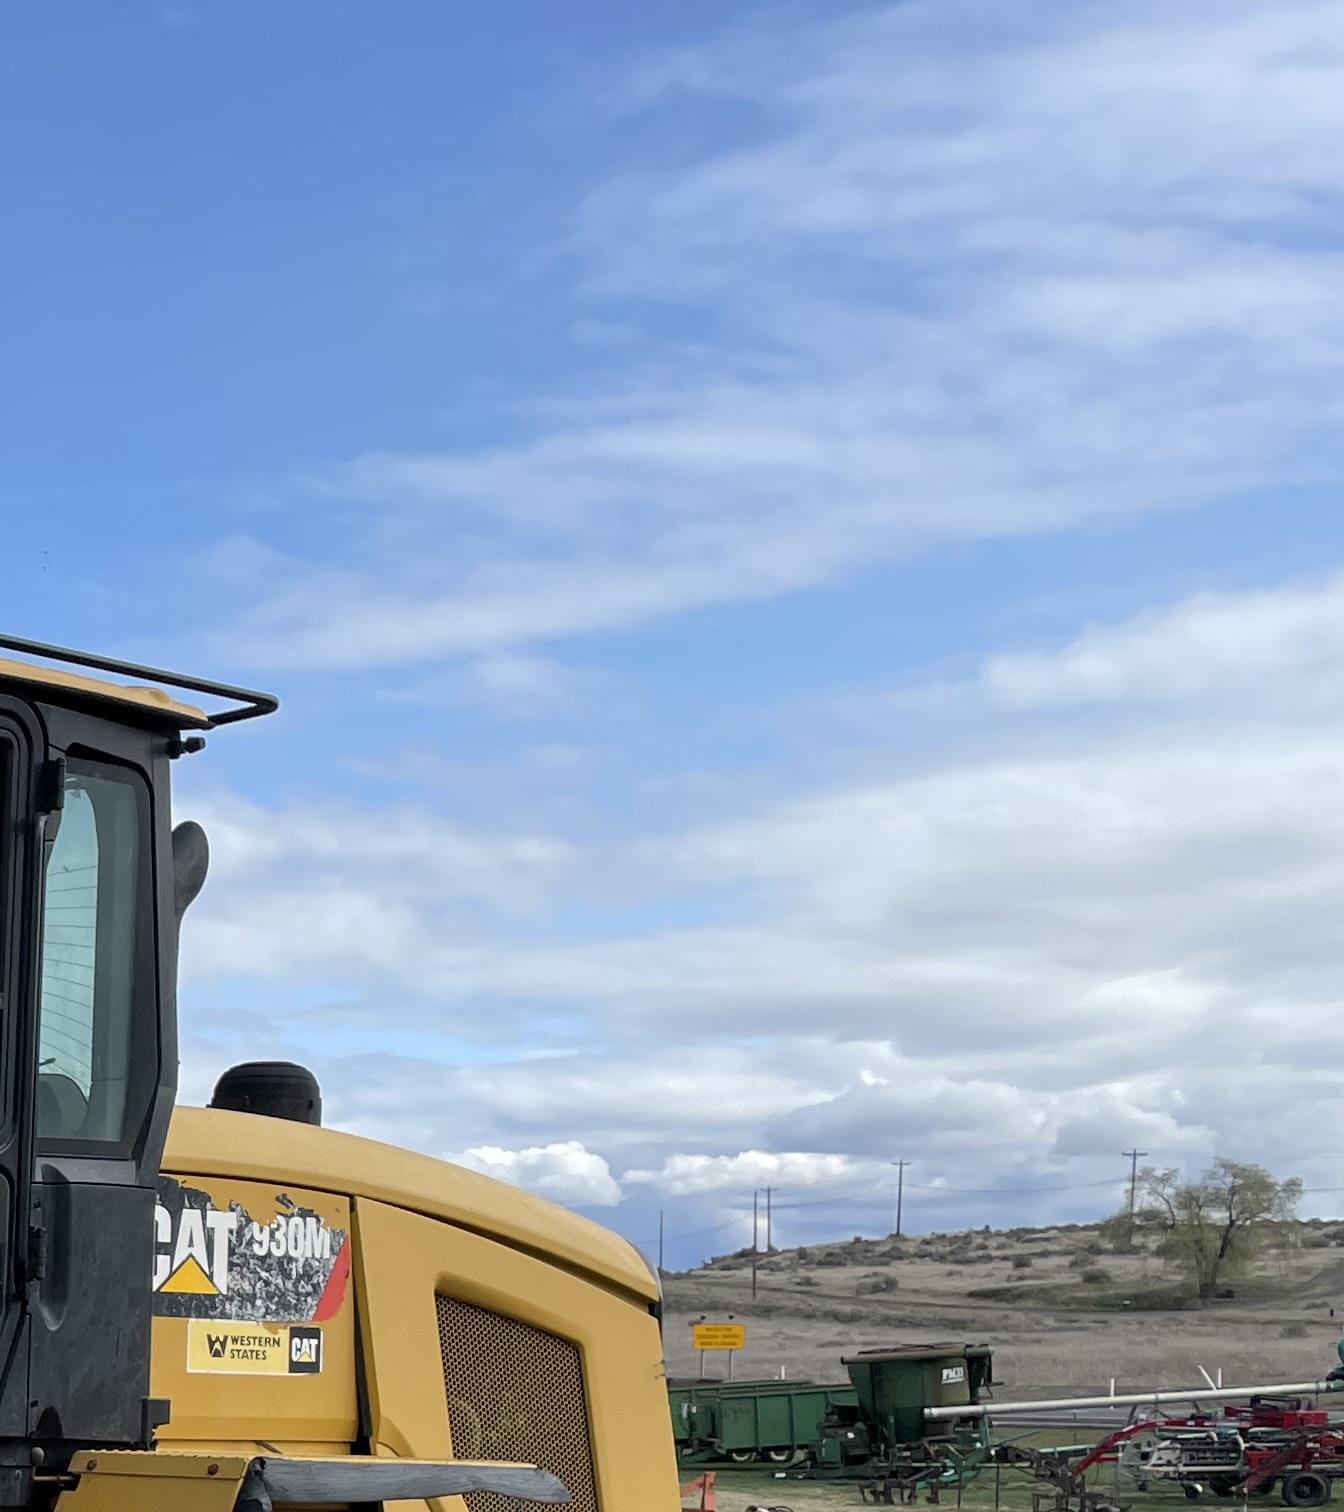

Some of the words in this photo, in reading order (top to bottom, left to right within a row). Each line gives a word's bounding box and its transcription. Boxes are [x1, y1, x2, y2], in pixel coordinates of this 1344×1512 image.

[230, 1335, 281, 1348] WESTERN
[230, 1348, 267, 1361] STATES
[291, 1337, 319, 1363] CAT
